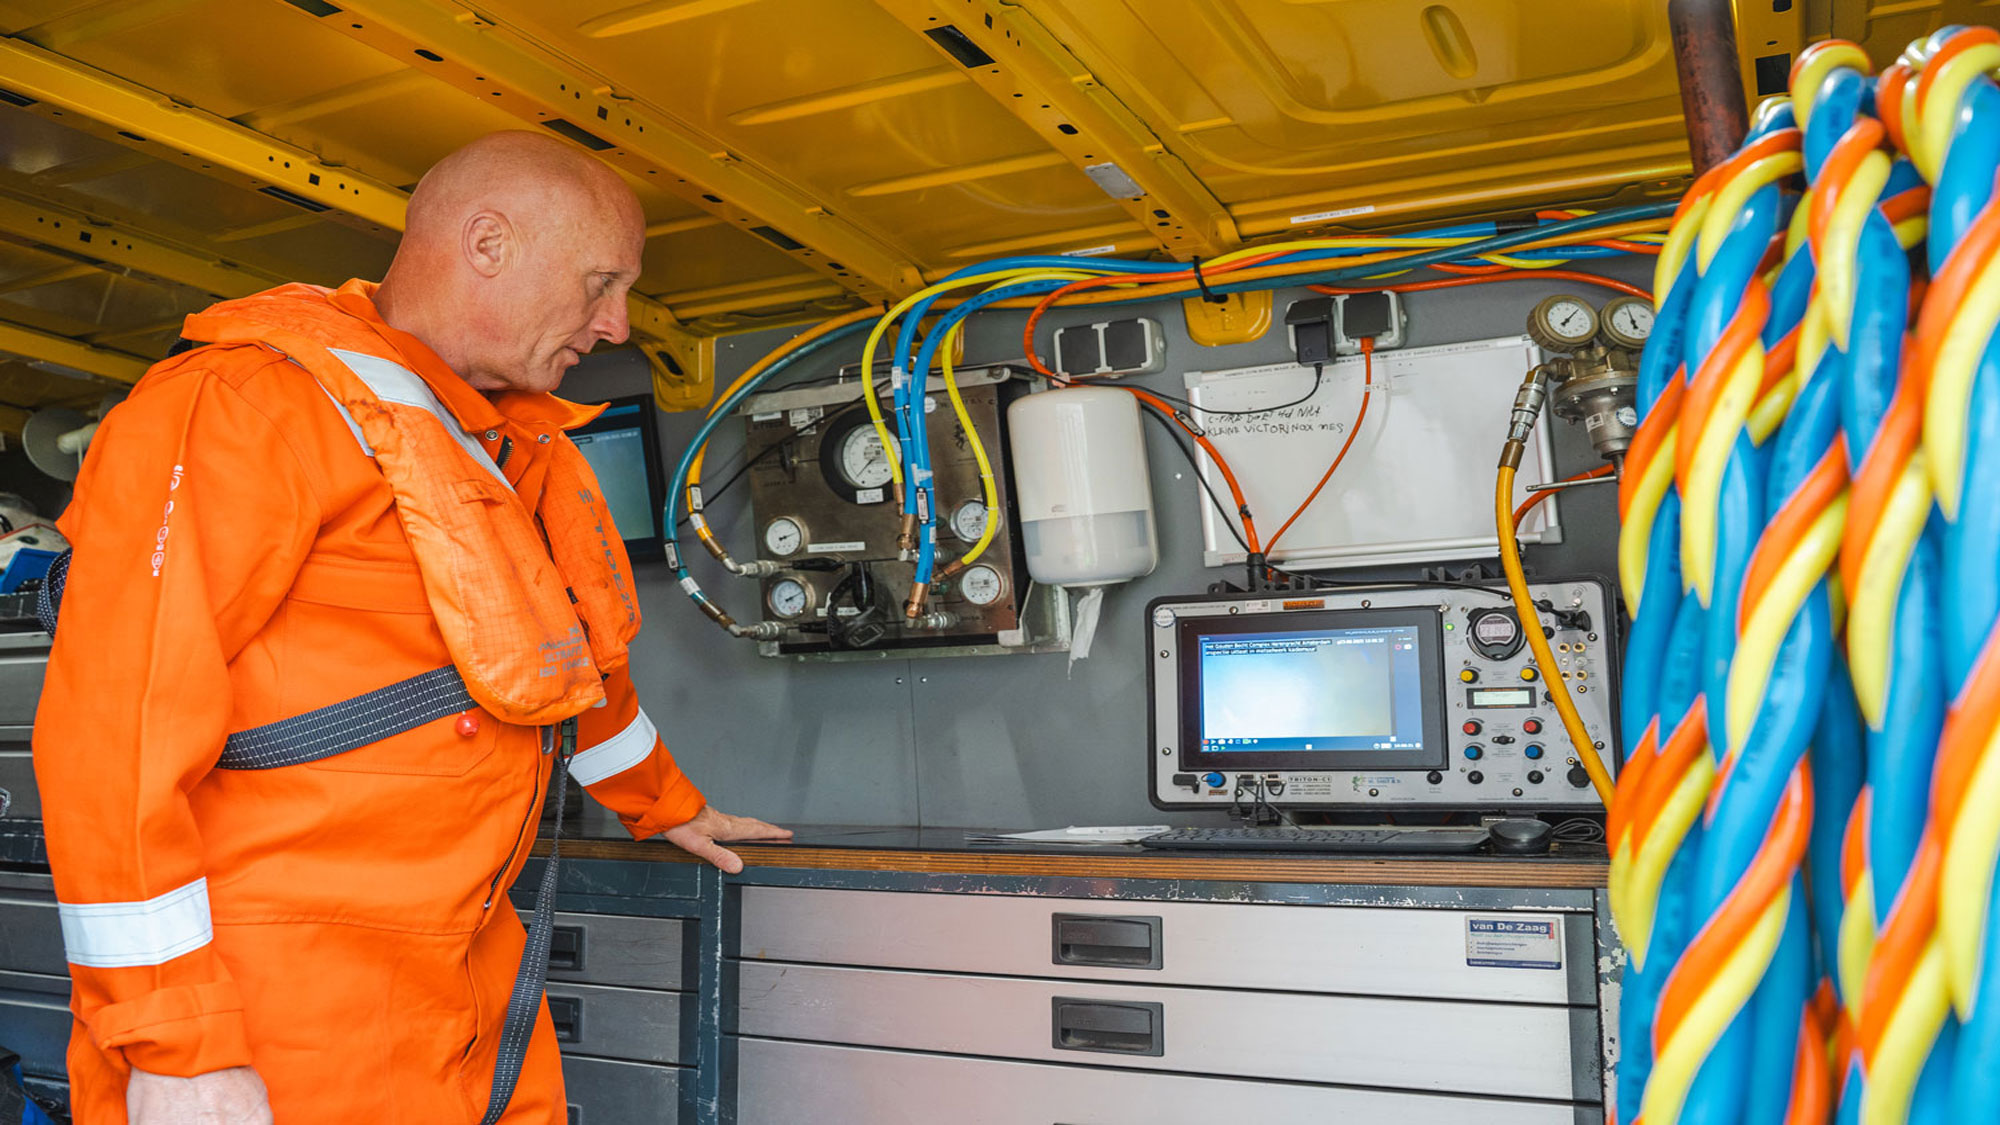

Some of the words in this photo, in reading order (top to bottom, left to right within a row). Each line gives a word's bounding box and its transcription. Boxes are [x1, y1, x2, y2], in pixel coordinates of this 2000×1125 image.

[539, 665, 557, 678] ISO
[1497, 922, 1513, 931] De
[1516, 923, 1547, 933] Zaag
